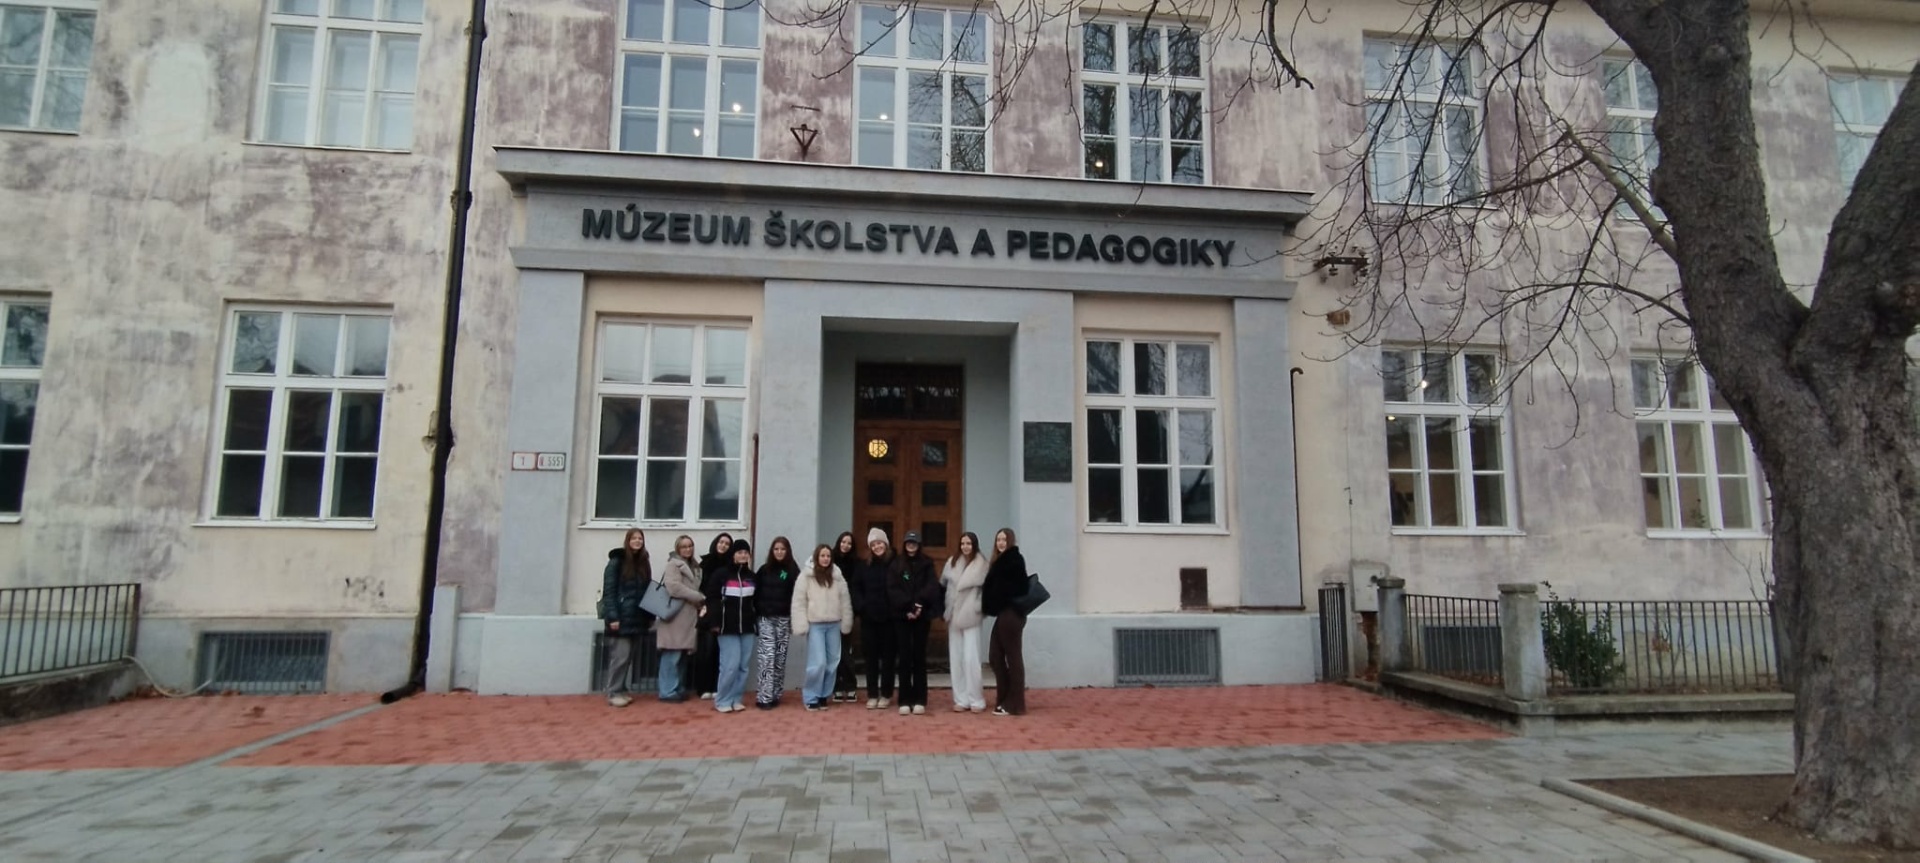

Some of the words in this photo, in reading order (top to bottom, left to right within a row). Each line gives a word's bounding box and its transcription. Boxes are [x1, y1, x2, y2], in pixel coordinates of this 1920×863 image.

[581, 203, 750, 245] MÚZEUM
[763, 210, 959, 255] ŠKOLSTVA
[970, 228, 996, 257] A
[1006, 229, 1236, 267] PEDAGOGIKY
